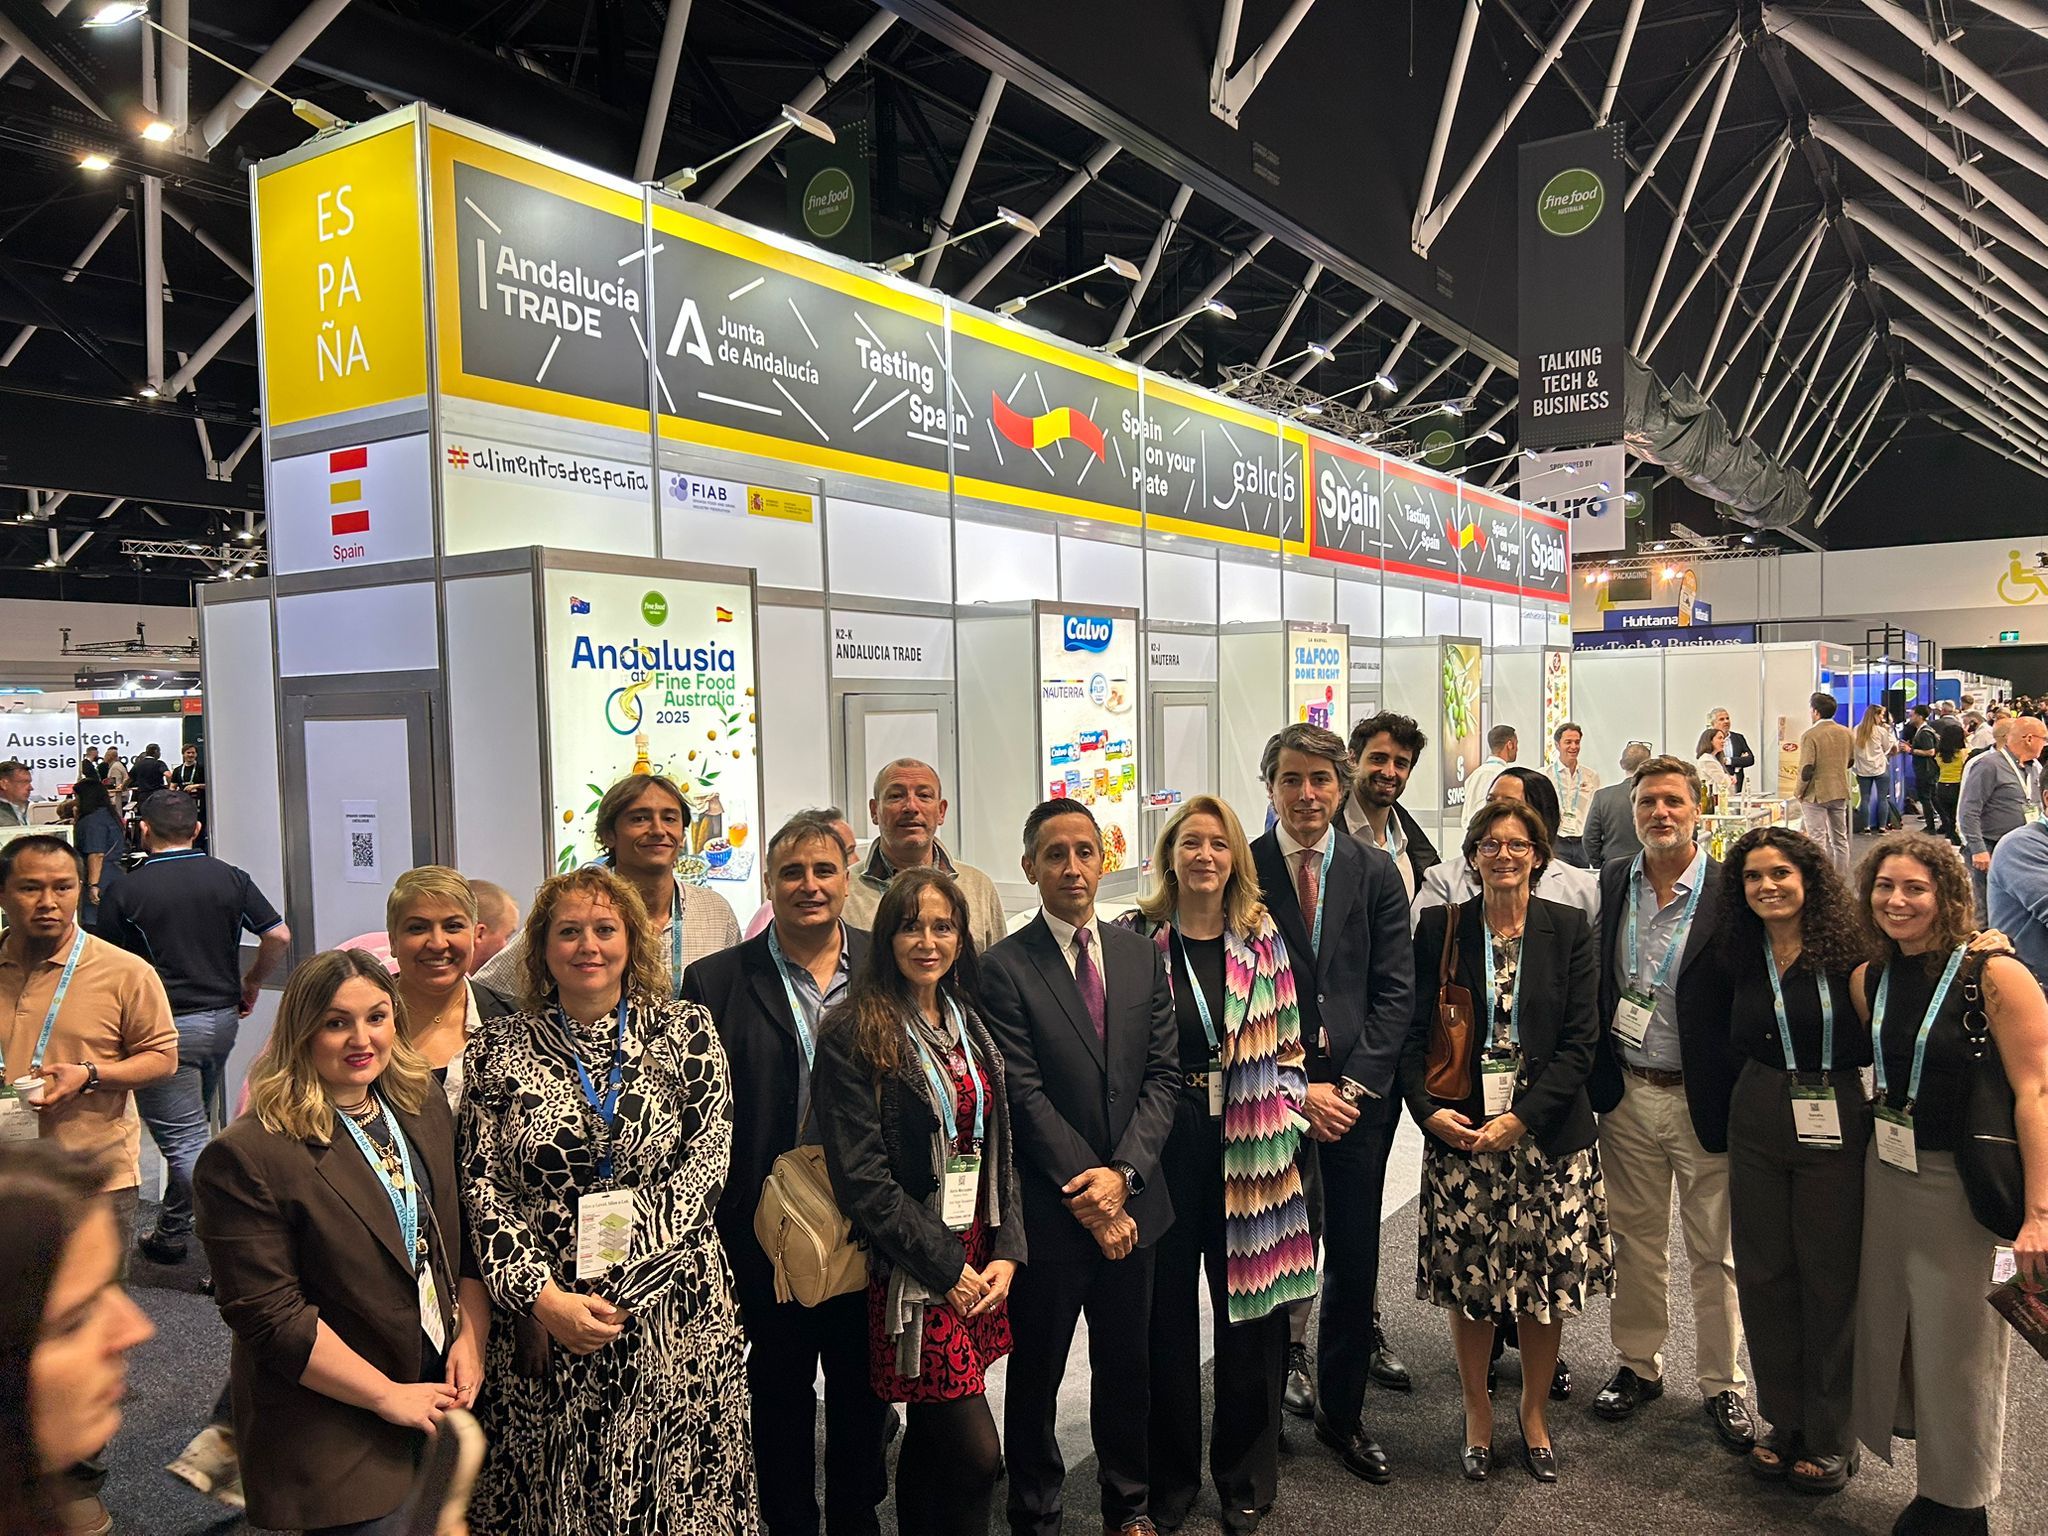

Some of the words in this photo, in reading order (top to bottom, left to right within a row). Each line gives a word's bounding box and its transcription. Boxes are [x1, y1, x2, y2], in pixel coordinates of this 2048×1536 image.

[1543, 192, 1569, 211] fine
[1569, 185, 1598, 205] food
[1557, 203, 1585, 216] AUSTRALIA
[317, 184, 355, 243] ES
[318, 255, 362, 312] PA
[496, 245, 640, 312] Andalucía
[496, 283, 602, 339] TRADE
[717, 315, 765, 347] Junta
[317, 320, 371, 382] ÑA
[717, 340, 740, 365] de
[742, 345, 820, 385] Andalucía
[1538, 346, 1602, 373] TALKING
[854, 337, 935, 395] Tasting
[1542, 372, 1582, 394] TECH
[1586, 369, 1599, 388] &
[908, 393, 969, 436] Spain
[1532, 390, 1610, 418] BUSINESS
[1121, 407, 1163, 443] Spain
[447, 443, 649, 492] #alimentosdespaña
[1145, 446, 1164, 465] on
[1165, 450, 1197, 475] your
[1585, 460, 1593, 468] BY
[692, 483, 728, 501] FIAB
[1131, 467, 1169, 497] Pate
[1320, 468, 1381, 532] Spain
[1404, 503, 1431, 529] Tasting
[1420, 527, 1441, 551] Spain
[1491, 520, 1508, 539] Spain
[333, 543, 365, 562] Spain
[1496, 554, 1511, 572] Plate
[1530, 532, 1565, 576] Spain
[1613, 570, 1648, 580] PACKAGING
[836, 628, 853, 640] K2-K
[1066, 616, 1110, 641] Calvo
[1622, 614, 1678, 628] Huhtama
[571, 635, 736, 672] Andalusia
[836, 643, 891, 661] ANDALUCIA
[893, 646, 922, 662] TRADE
[1150, 653, 1180, 667] NAUTERRA
[1295, 646, 1340, 666] SEAFOOD
[631, 669, 646, 682] at
[655, 672, 691, 690] Fine
[696, 673, 736, 690] Food
[1295, 667, 1316, 680] DONE
[1317, 668, 1340, 680] RIGHT
[664, 690, 735, 707] Australia
[1043, 686, 1085, 699] NAUTERRA
[656, 710, 690, 724] 2025
[6, 731, 76, 748] Aussie
[81, 730, 130, 747] tech,
[935, 1079, 952, 1119] superkick
[344, 1114, 360, 1135] tand
[357, 1132, 371, 1151] B45
[407, 1206, 416, 1258] superkick
